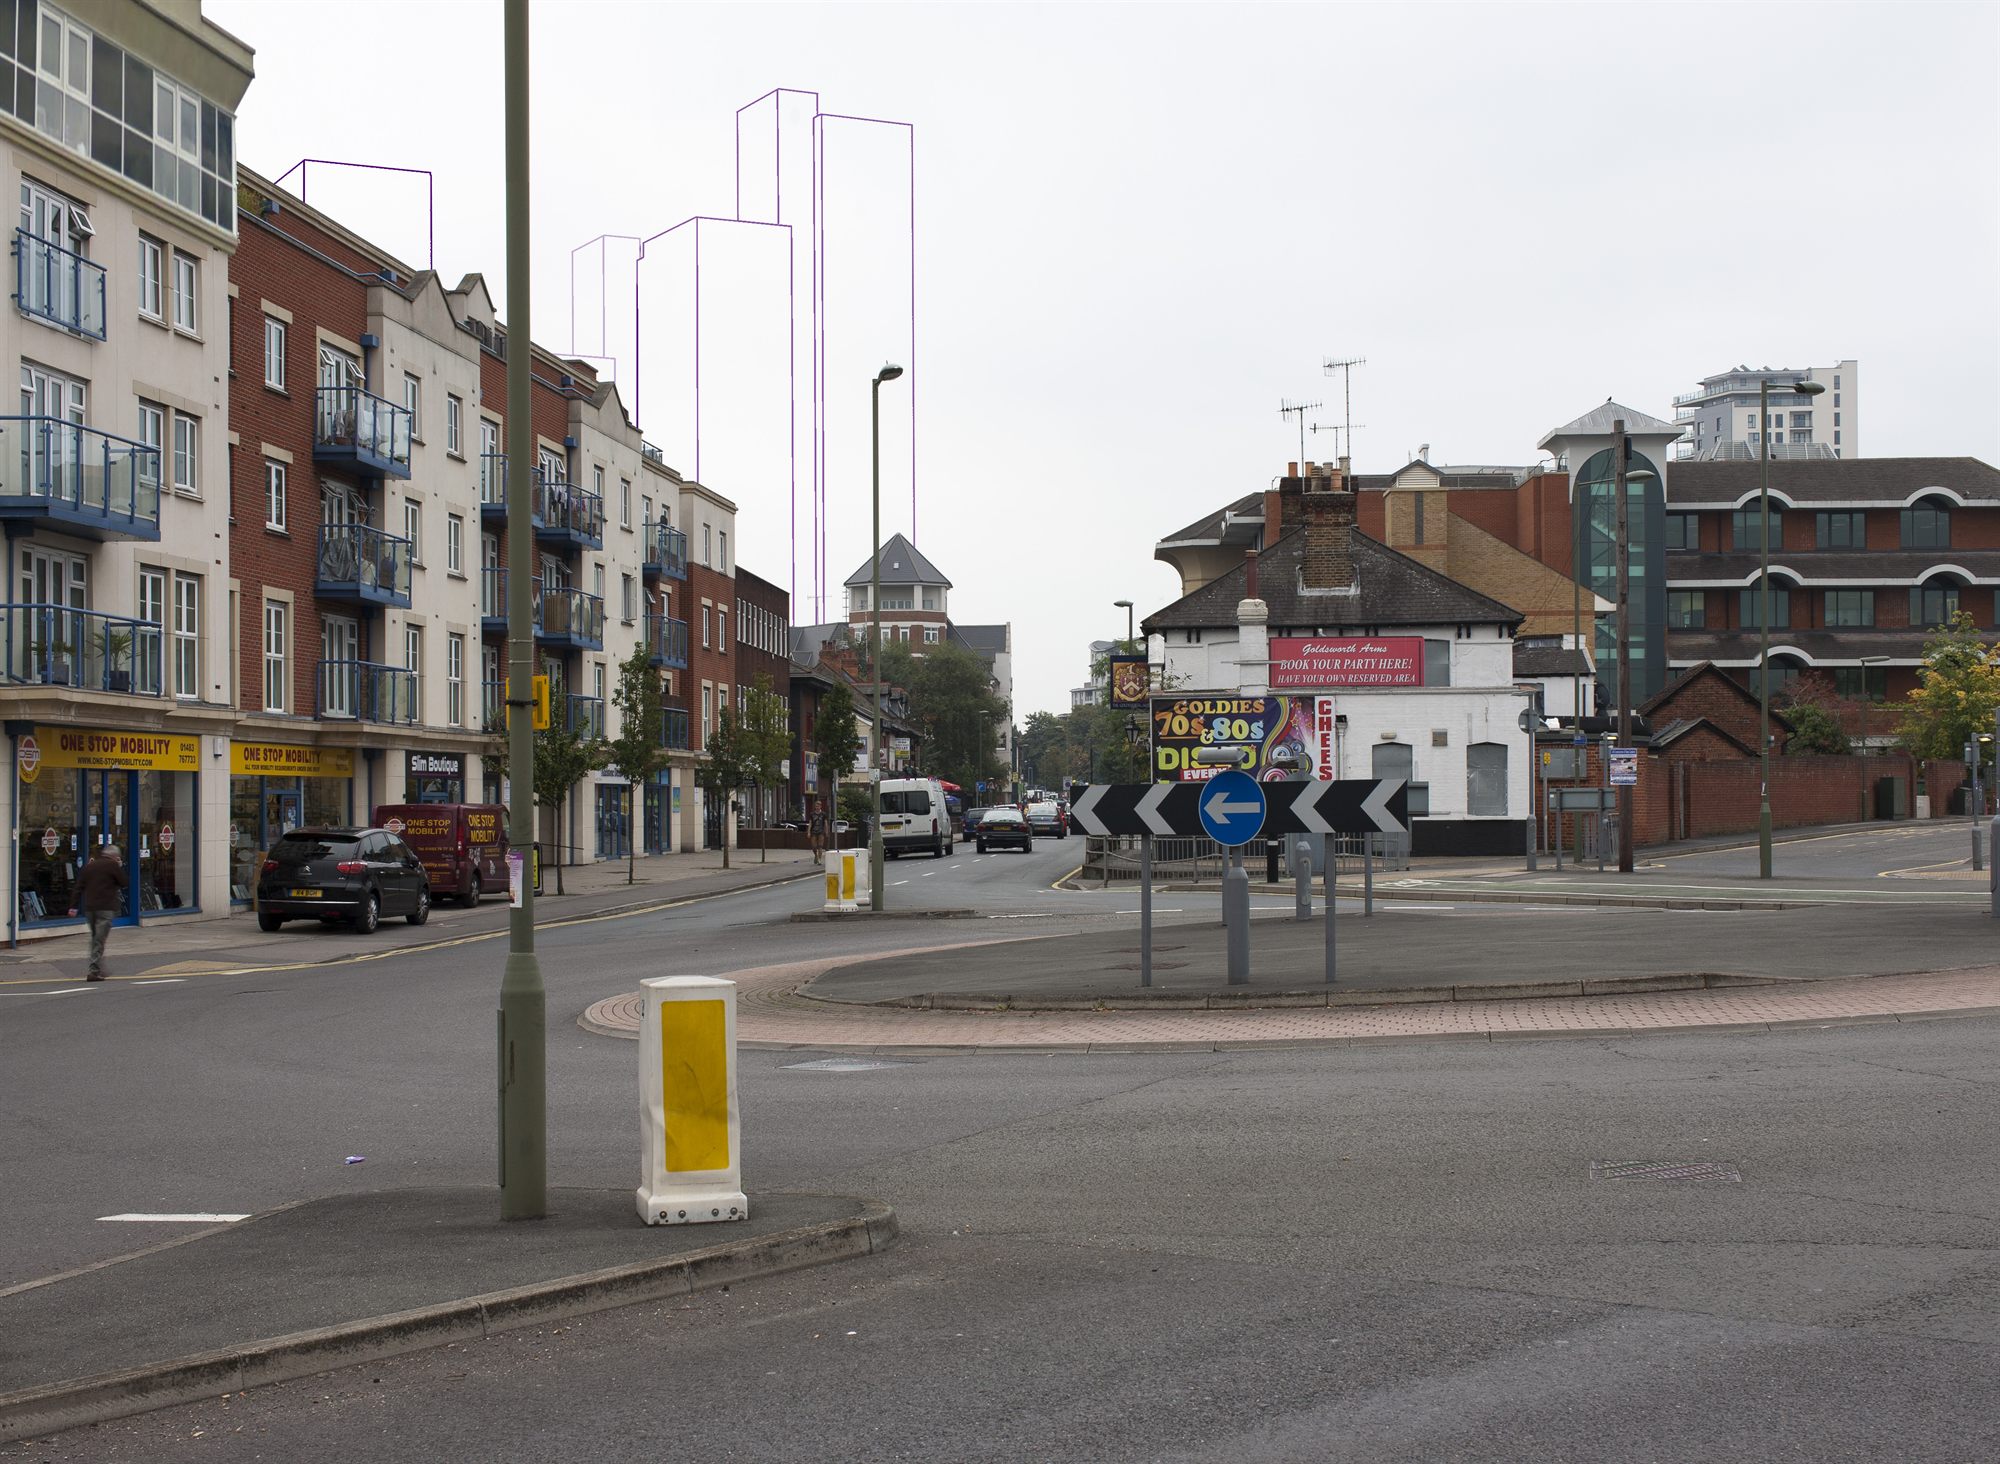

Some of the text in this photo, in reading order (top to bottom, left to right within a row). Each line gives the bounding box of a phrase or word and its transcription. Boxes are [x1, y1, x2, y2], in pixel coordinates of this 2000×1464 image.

[1302, 643, 1387, 656] Goldsworth Arms
[1280, 658, 1413, 670] BOOK YOUR PARTY HERE!
[1278, 674, 1416, 683] HAVE YOUR OWN RESERVED AREA
[1173, 700, 1265, 714] GOLDIES
[1200, 729, 1214, 744] &
[61, 734, 170, 755] ONE STOP MOBILITY
[243, 747, 261, 761] ONE
[263, 748, 283, 762] STOP
[286, 750, 321, 764] MOBILITY
[411, 755, 458, 775] Slim Boutique
[407, 819, 425, 827] ONE
[428, 819, 451, 827] STOP
[469, 815, 495, 827] ONE STOP
[471, 830, 496, 843] MOBILITY
